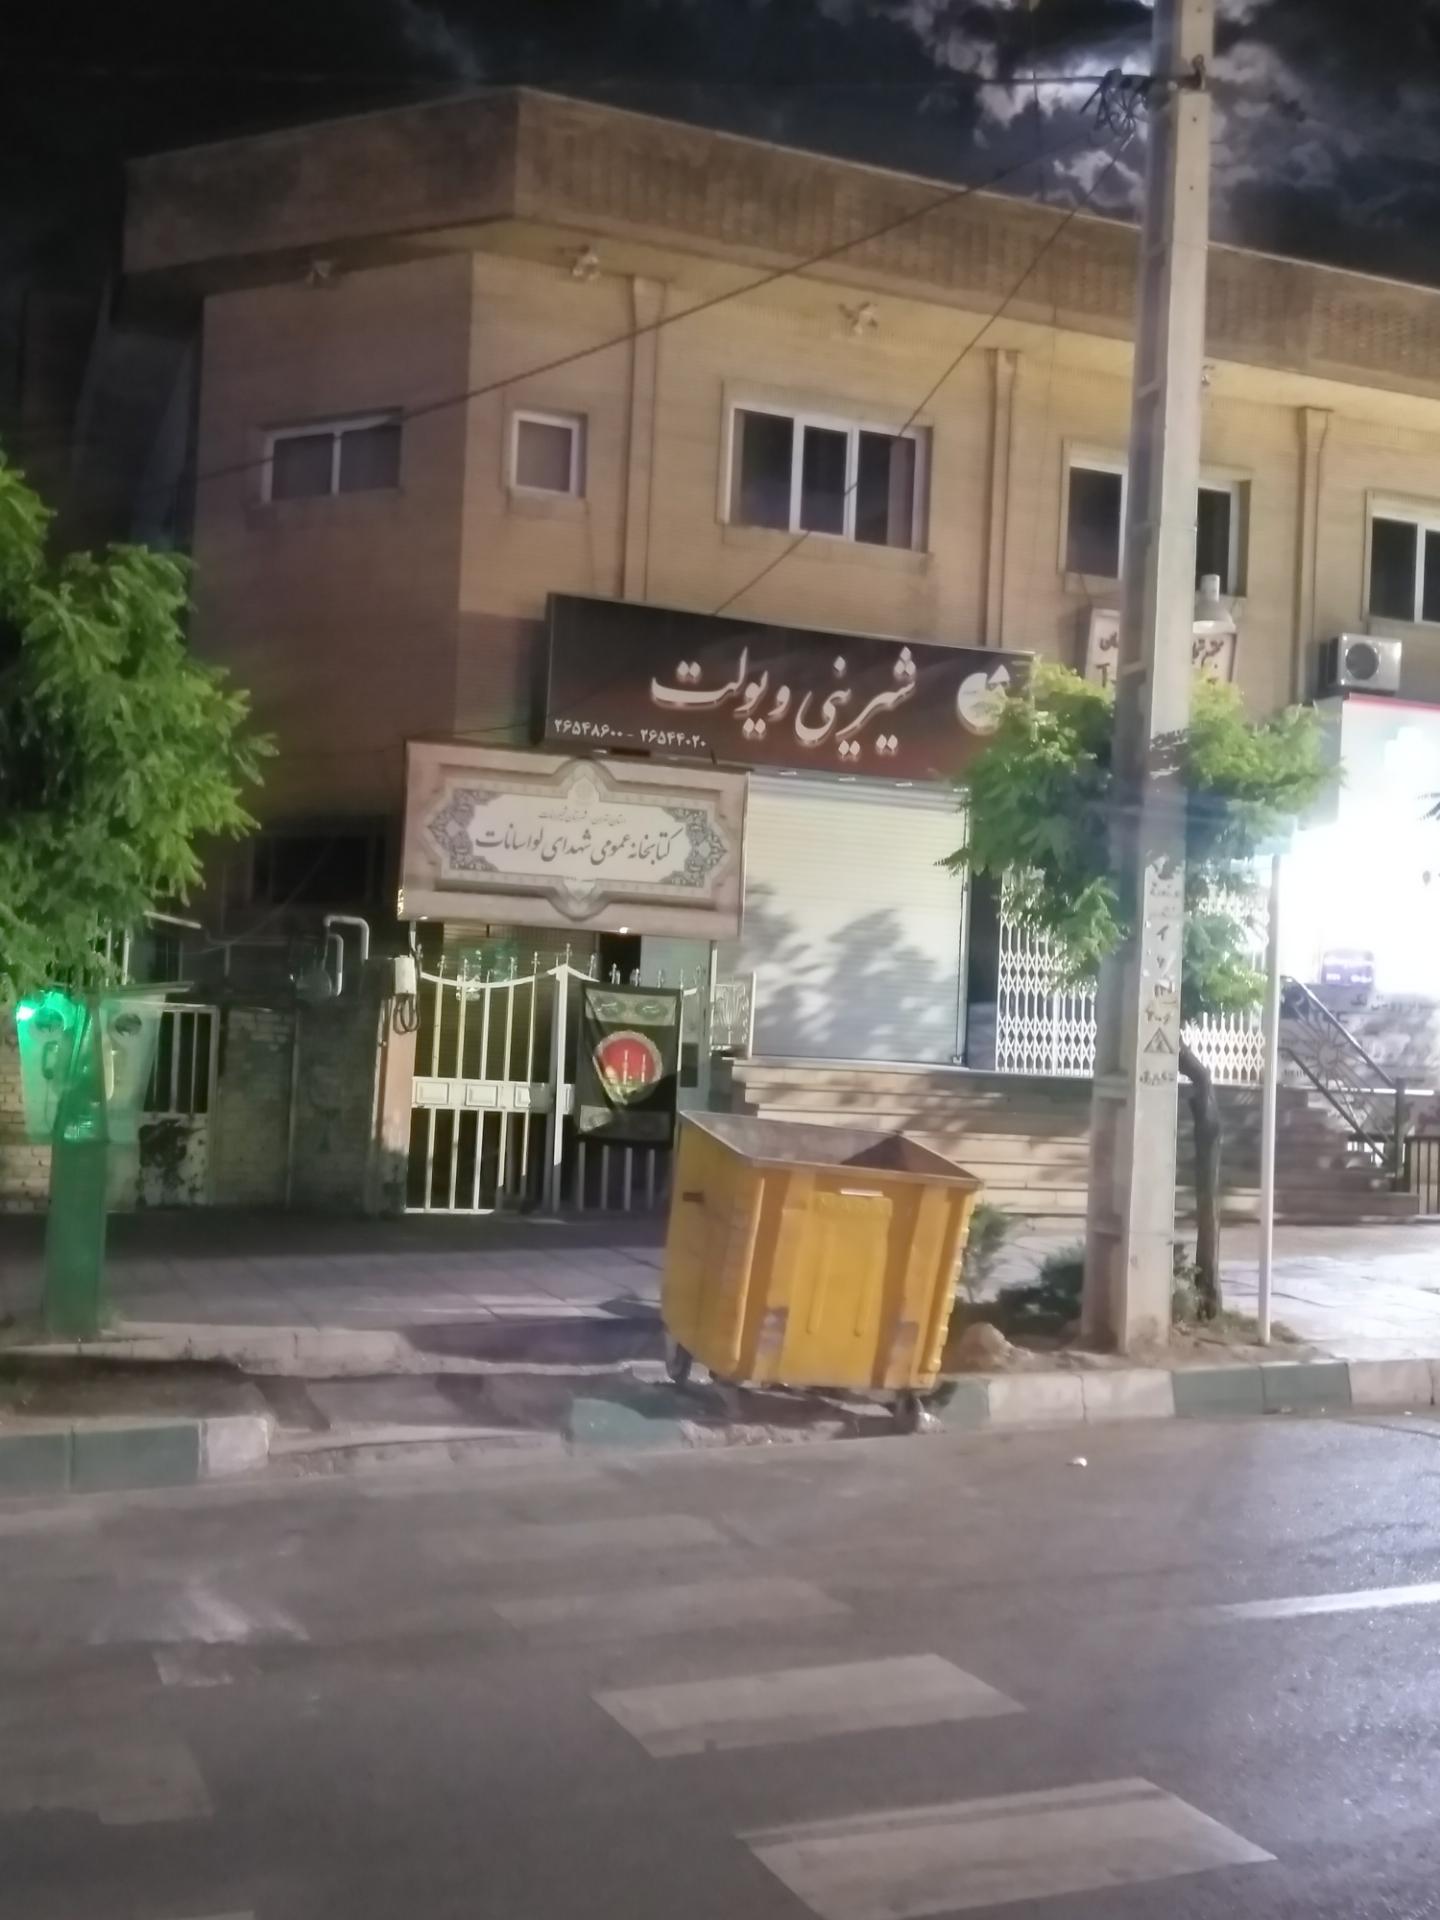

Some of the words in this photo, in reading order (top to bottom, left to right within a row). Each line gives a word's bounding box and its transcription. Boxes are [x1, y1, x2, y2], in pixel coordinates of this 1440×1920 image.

[795, 646, 917, 757] شیرینی
[475, 823, 544, 850] لواسانات
[541, 828, 592, 863] شهدای
[590, 834, 631, 866] عمومی
[627, 827, 684, 865] کتابخانه
